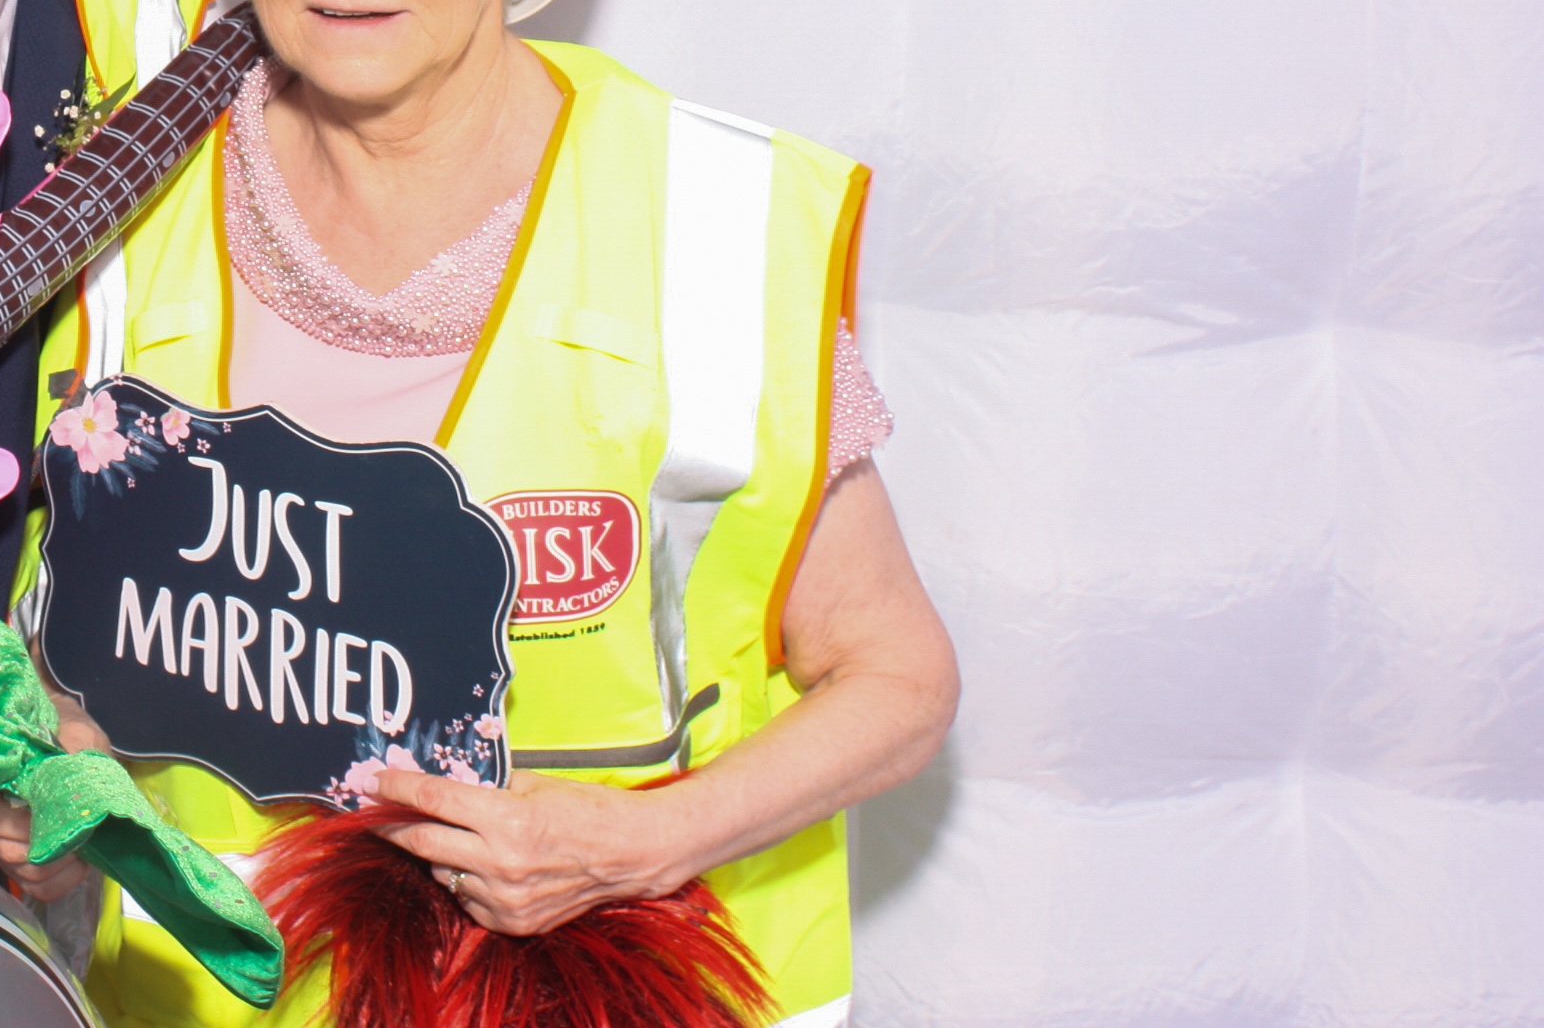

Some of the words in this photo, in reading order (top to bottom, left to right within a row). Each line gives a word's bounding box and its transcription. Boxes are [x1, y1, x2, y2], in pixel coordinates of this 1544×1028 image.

[178, 456, 353, 603] JUST
[502, 500, 602, 520] BUILDERS
[510, 520, 616, 585] ISK
[514, 576, 620, 613] NTRACTORS
[580, 622, 606, 635] 1859
[115, 577, 413, 733] MARRIED
